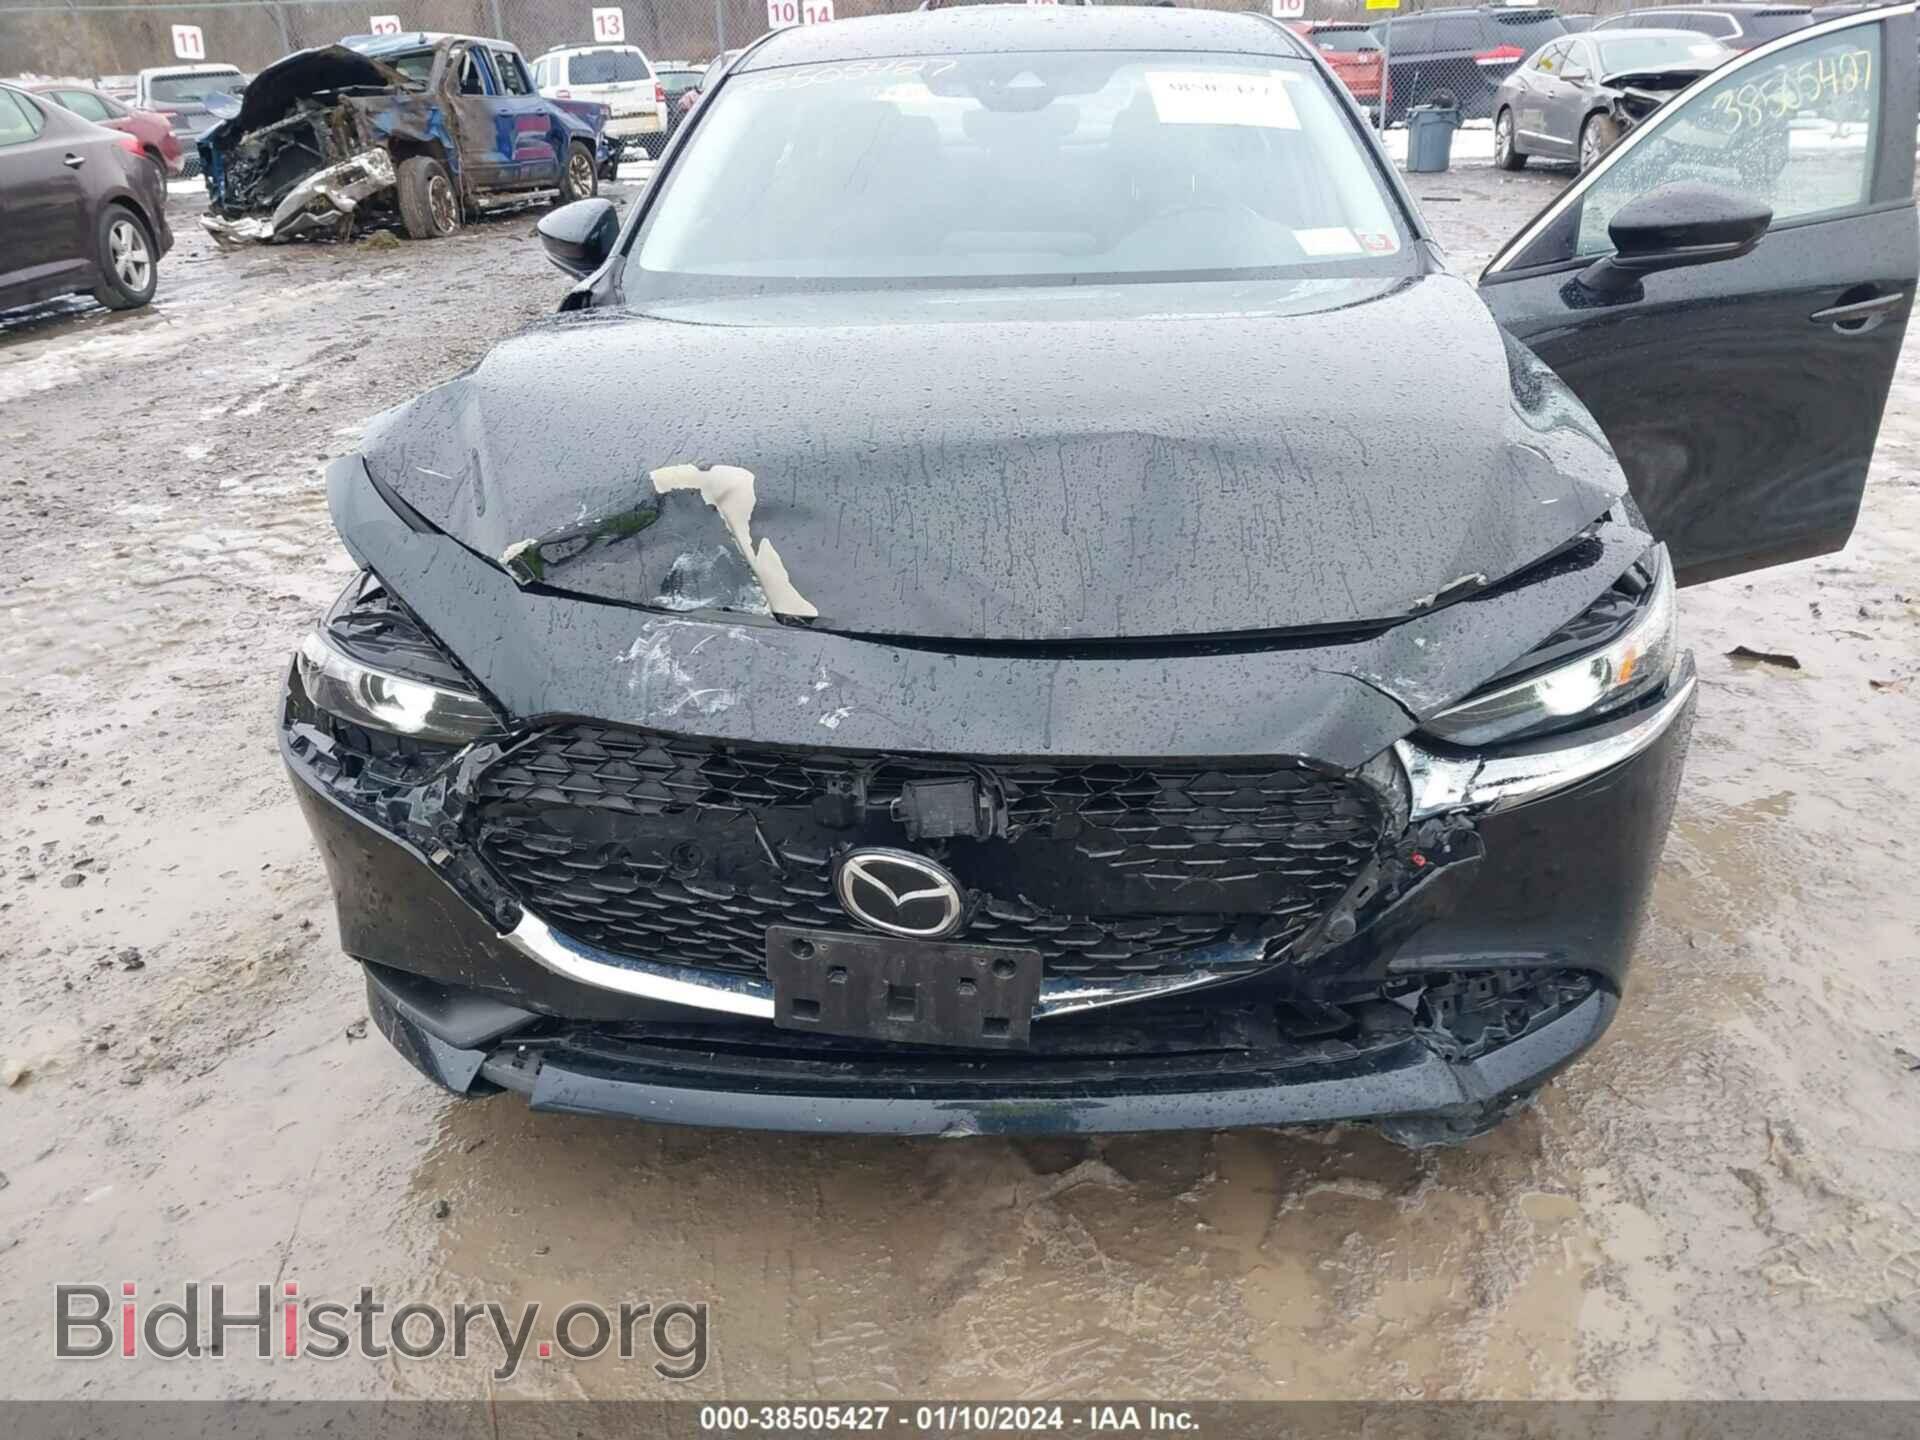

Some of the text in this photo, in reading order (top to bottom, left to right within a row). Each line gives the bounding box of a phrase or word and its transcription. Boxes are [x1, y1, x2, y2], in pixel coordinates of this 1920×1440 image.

[771, 2, 795, 22] 10
[805, 5, 831, 25] 14
[595, 14, 621, 36] 13
[177, 32, 200, 53] 11
[1711, 50, 1872, 134] 38505427
